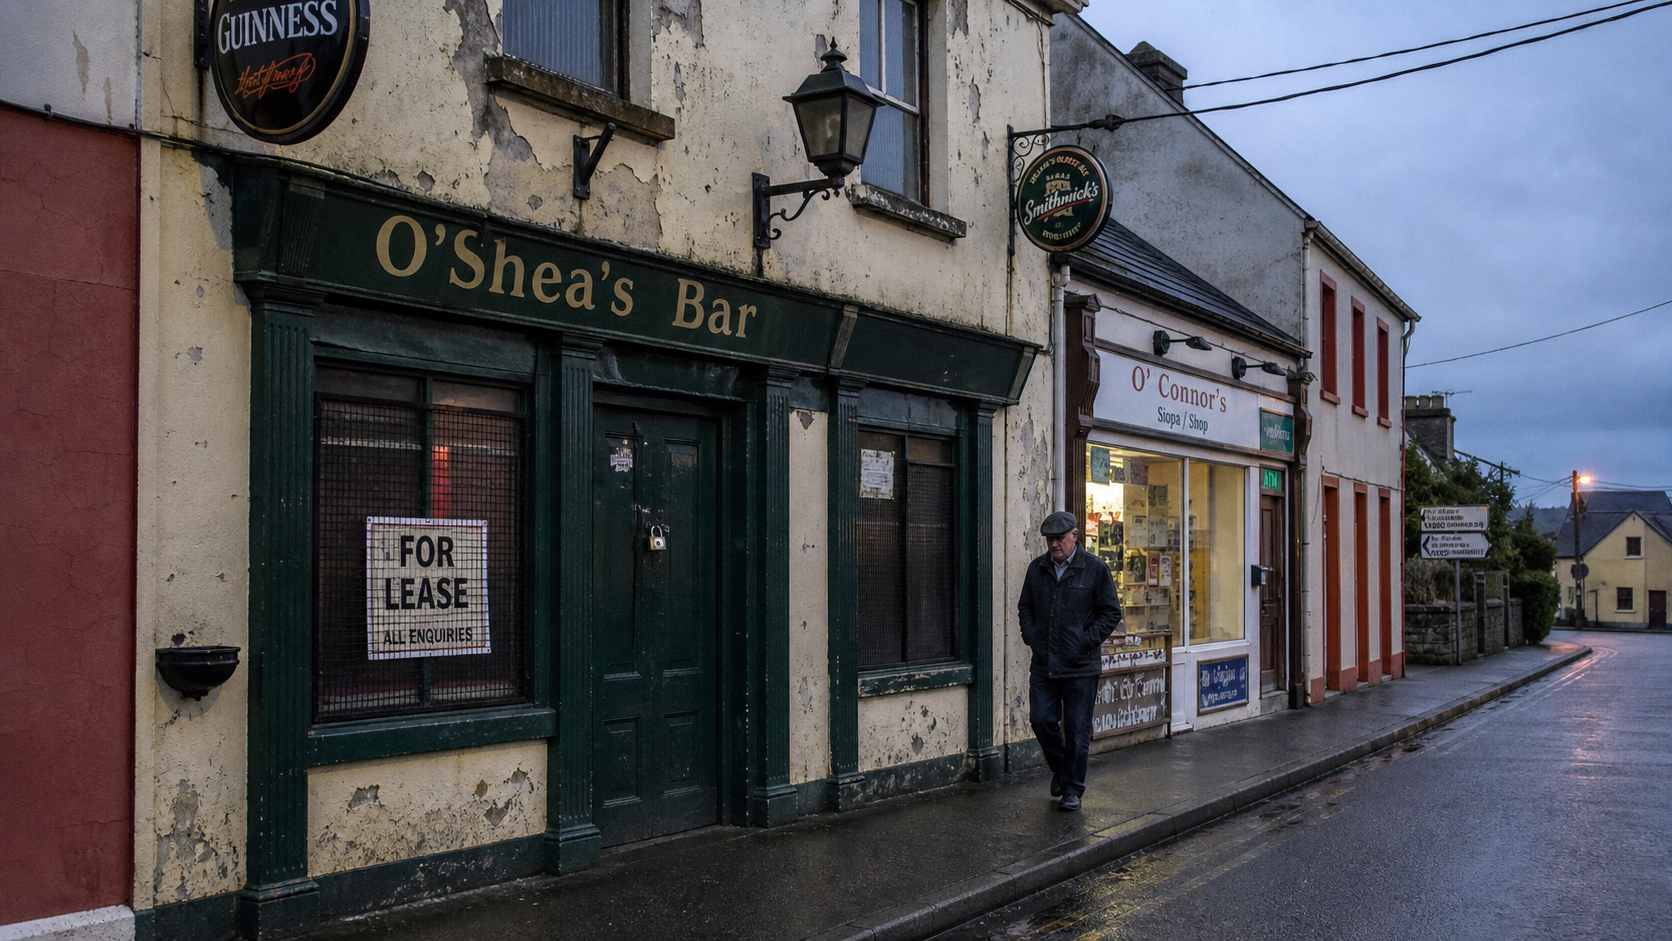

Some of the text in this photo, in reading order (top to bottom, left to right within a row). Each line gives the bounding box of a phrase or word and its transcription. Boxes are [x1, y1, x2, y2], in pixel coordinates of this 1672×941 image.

[218, 0, 338, 54] GUINNESS
[1024, 181, 1099, 225] Smithwick's
[376, 215, 757, 338] O'Shea's Bar
[1158, 373, 1227, 413] Connor's
[1158, 406, 1181, 429] Siopa
[1189, 414, 1208, 435] Shop
[400, 535, 454, 567] FOR
[385, 578, 469, 610] LEASE
[383, 627, 473, 645] ALL ENQUIRIES
